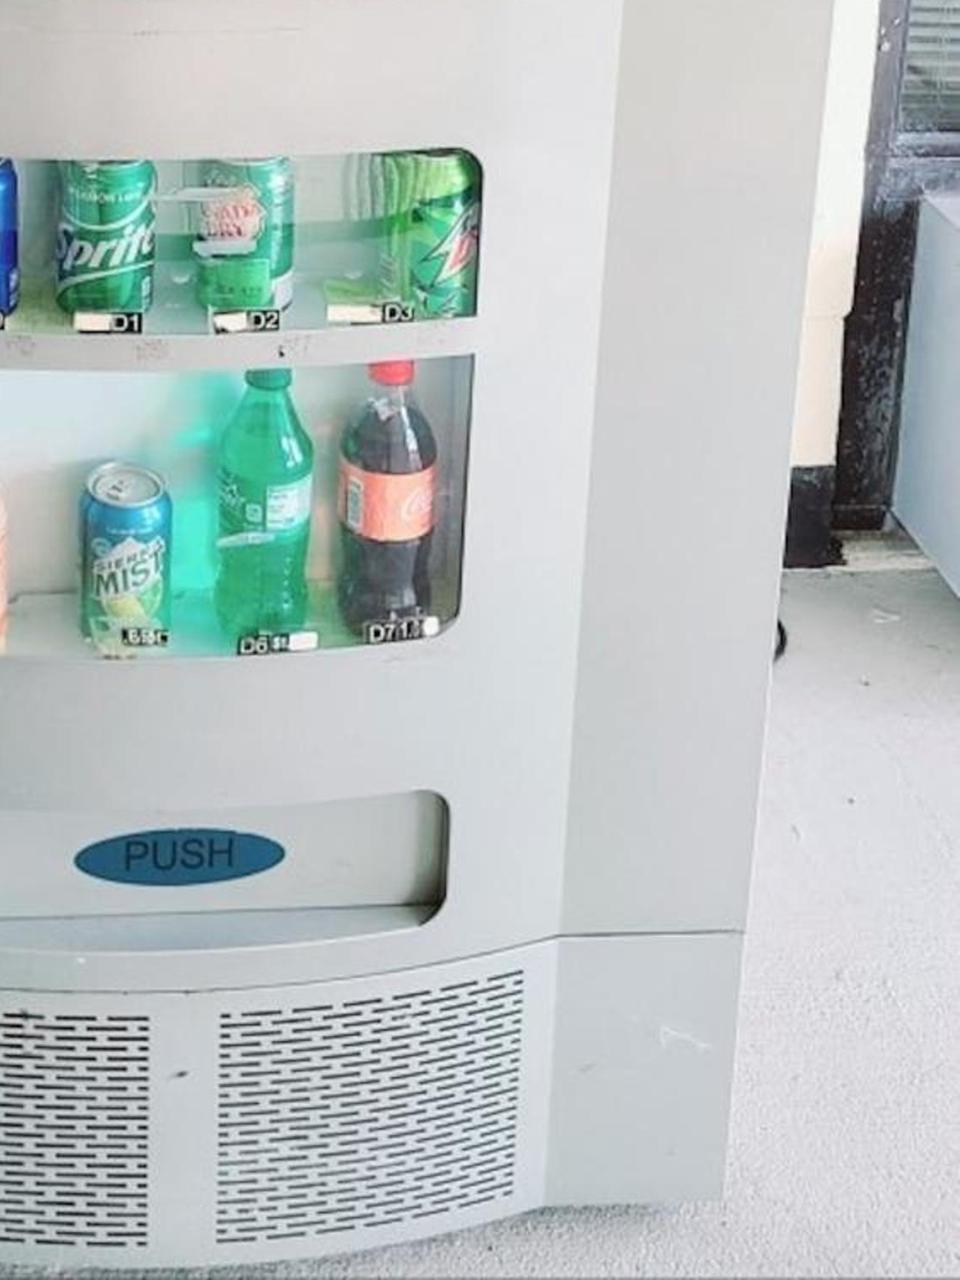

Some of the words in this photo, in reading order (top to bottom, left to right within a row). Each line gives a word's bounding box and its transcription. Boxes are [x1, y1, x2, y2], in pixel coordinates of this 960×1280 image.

[111, 314, 140, 331] D1
[251, 311, 278, 330] D2
[95, 551, 161, 597] MIST
[369, 623, 395, 643] D7
[240, 637, 269, 654] D6
[124, 837, 235, 872] PUSH
